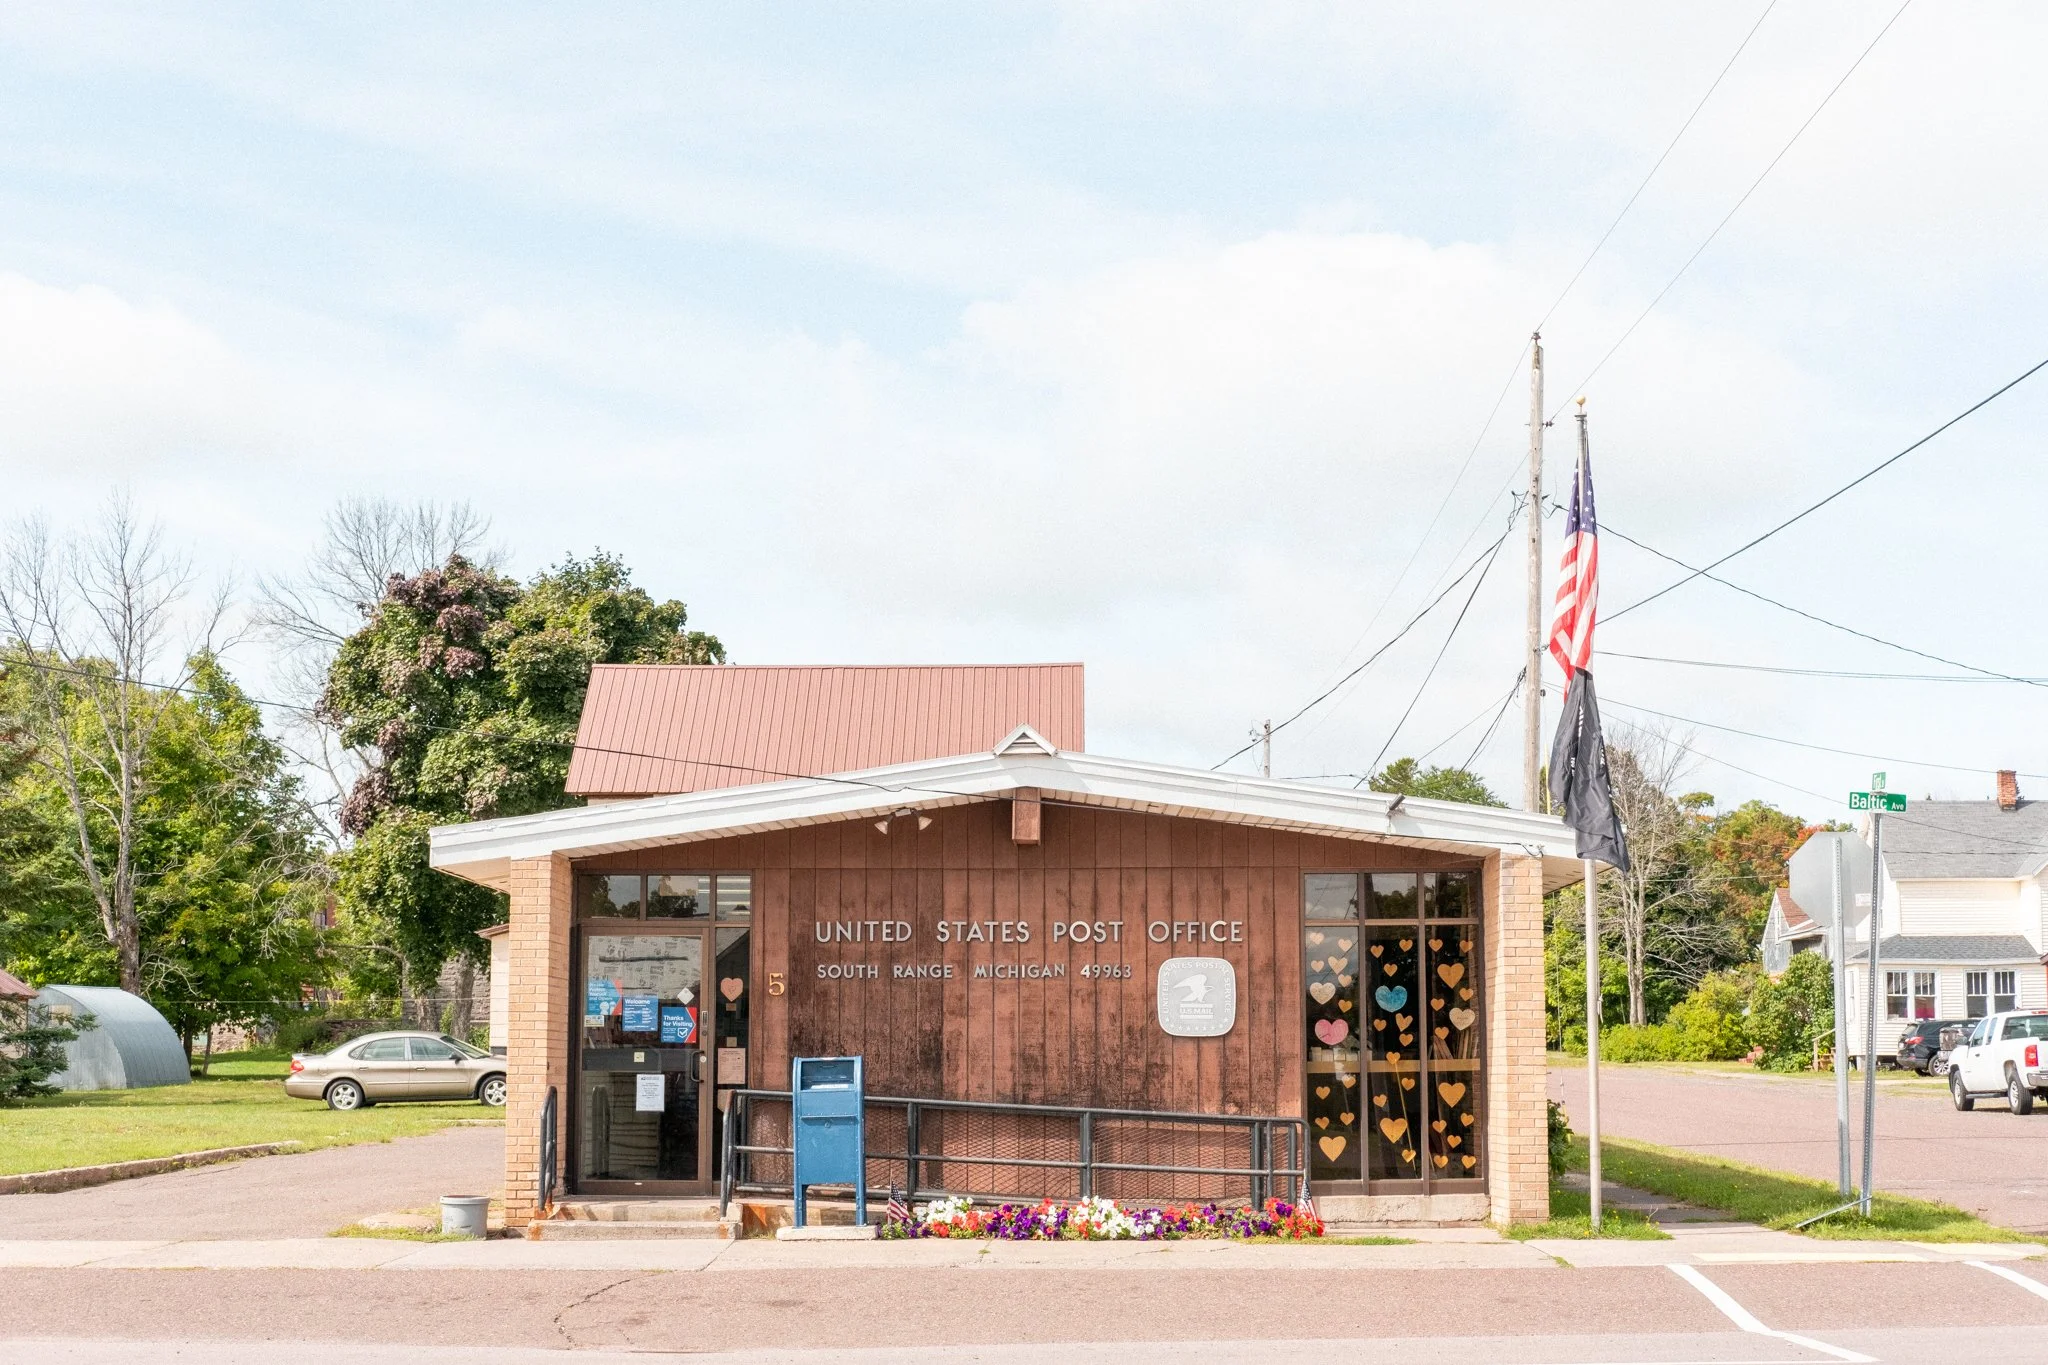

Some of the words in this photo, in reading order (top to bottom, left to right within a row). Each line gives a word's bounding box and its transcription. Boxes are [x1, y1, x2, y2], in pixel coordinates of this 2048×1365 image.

[1851, 794, 1887, 809] Baltic
[1891, 802, 1904, 811] Ave
[815, 920, 912, 943] UNITED
[936, 920, 1030, 943] STATES
[1053, 920, 1124, 943] POST
[1147, 920, 1243, 943] OFFICE
[817, 963, 879, 979] SOUTH
[893, 963, 953, 979] RANGE
[973, 963, 1065, 979] MICHIGAN
[1080, 963, 1132, 978] 49963
[1163, 961, 1193, 977] STATES
[1195, 961, 1230, 975] POSTAL
[769, 972, 785, 996] 5
[1162, 979, 1170, 1014] UNITED
[1224, 977, 1232, 1013] SERVICE
